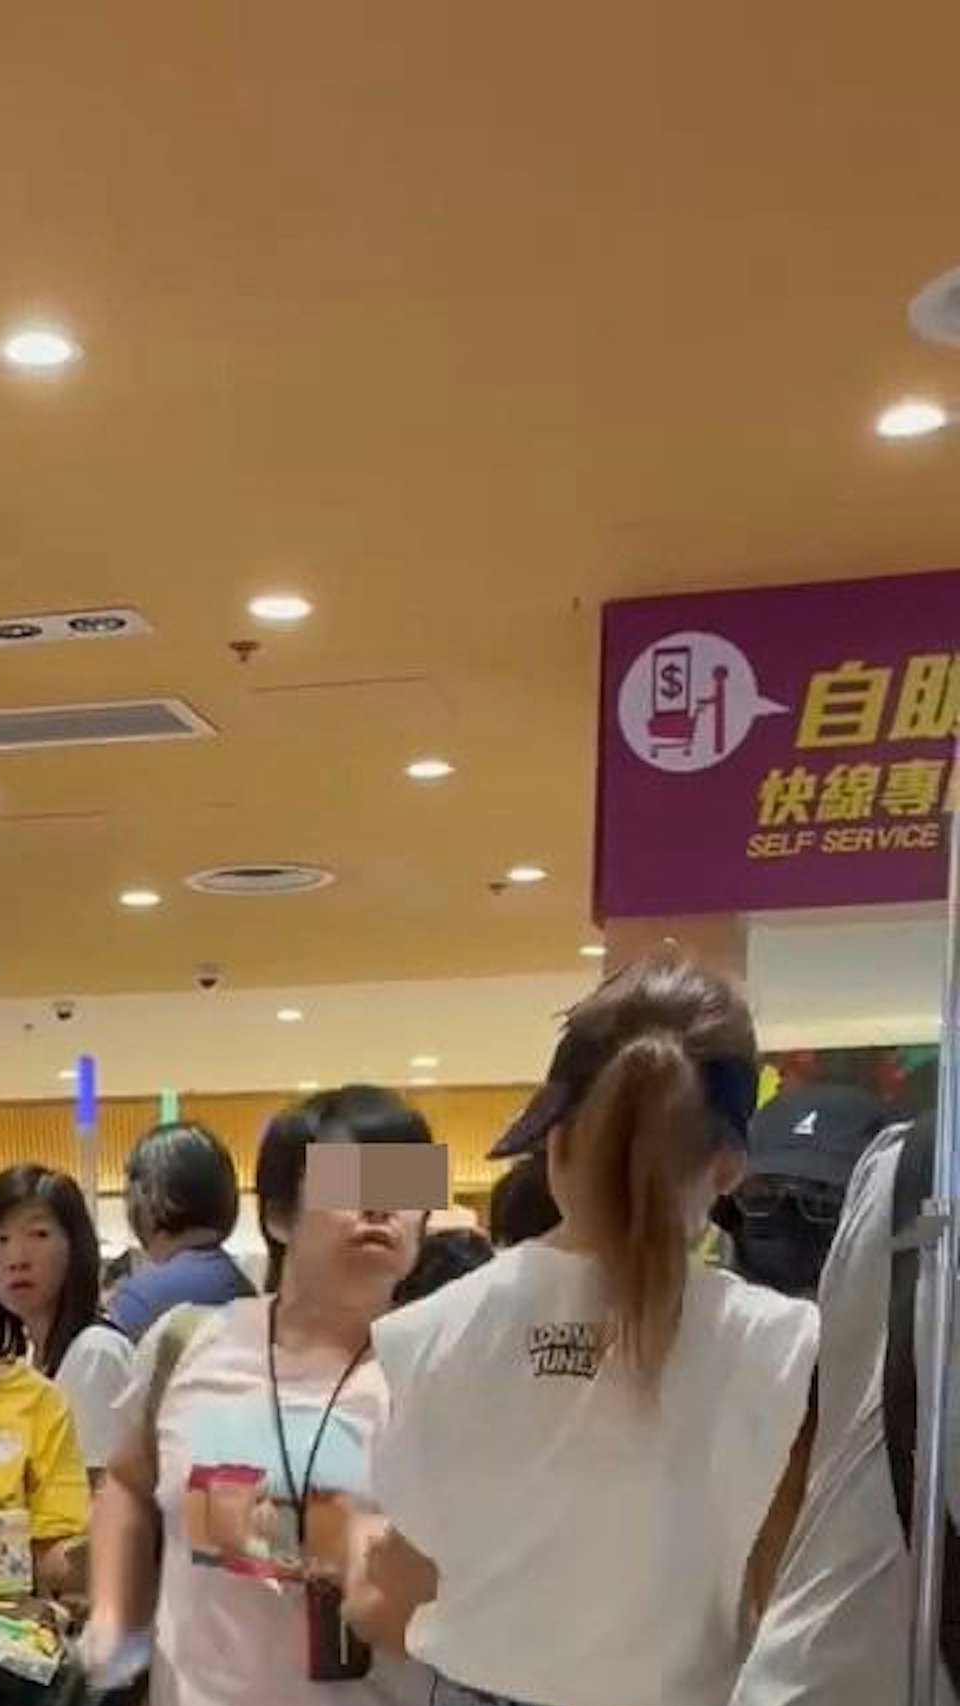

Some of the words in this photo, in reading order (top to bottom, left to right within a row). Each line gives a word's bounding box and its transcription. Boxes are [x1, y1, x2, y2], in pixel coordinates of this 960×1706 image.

[757, 758, 960, 826] 快線專
[746, 830, 815, 859] SELF
[821, 822, 940, 853] SERVICE
